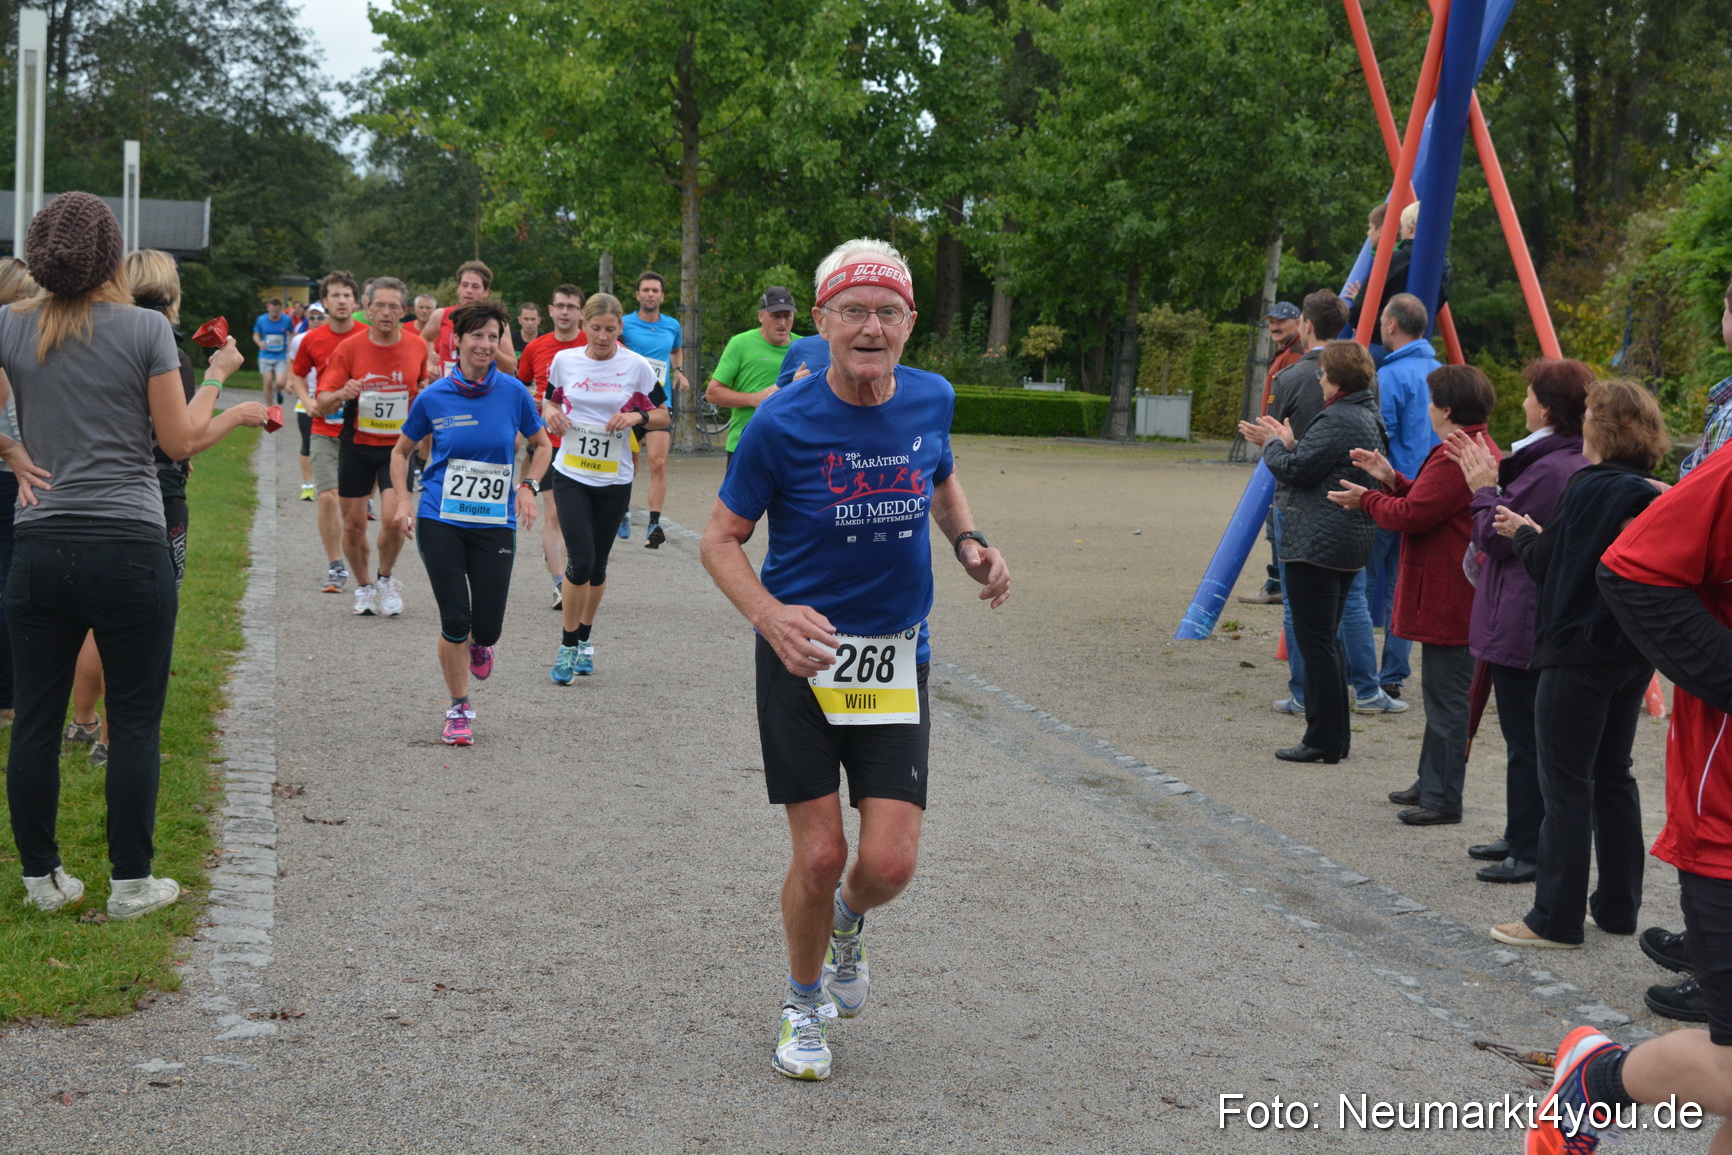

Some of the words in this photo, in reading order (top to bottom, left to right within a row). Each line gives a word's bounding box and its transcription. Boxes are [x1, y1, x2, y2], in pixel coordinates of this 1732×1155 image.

[374, 403, 395, 418] 57
[370, 420, 396, 428] Andreas
[579, 436, 610, 458] 131
[449, 464, 469, 473] PARTL
[470, 467, 501, 476] Neumarkt
[580, 460, 602, 470] Heike
[450, 474, 505, 500] 2739
[459, 503, 491, 515] Brigitte
[835, 504, 863, 520] DU
[867, 496, 926, 517] MEDOC
[873, 514, 913, 524] SEPTEMBRE
[833, 643, 896, 683] 268
[845, 693, 877, 709] Willi
